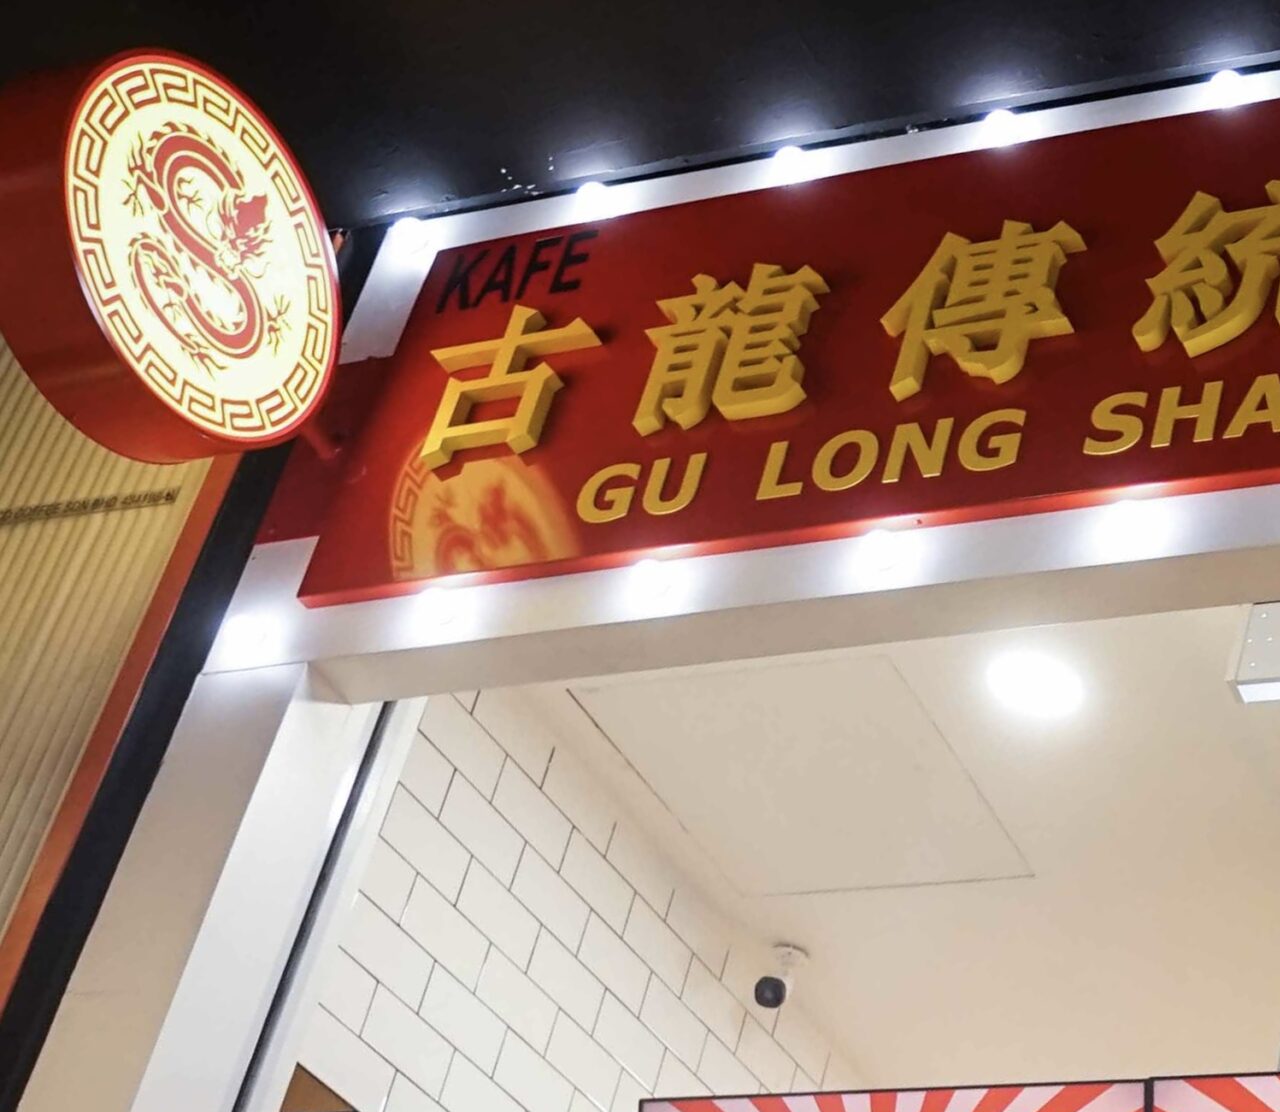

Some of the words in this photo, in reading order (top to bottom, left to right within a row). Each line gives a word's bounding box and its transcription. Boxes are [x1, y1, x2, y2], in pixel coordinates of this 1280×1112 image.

[435, 228, 599, 314] KAFE
[575, 453, 706, 524] GU
[755, 409, 1028, 502] LONG
